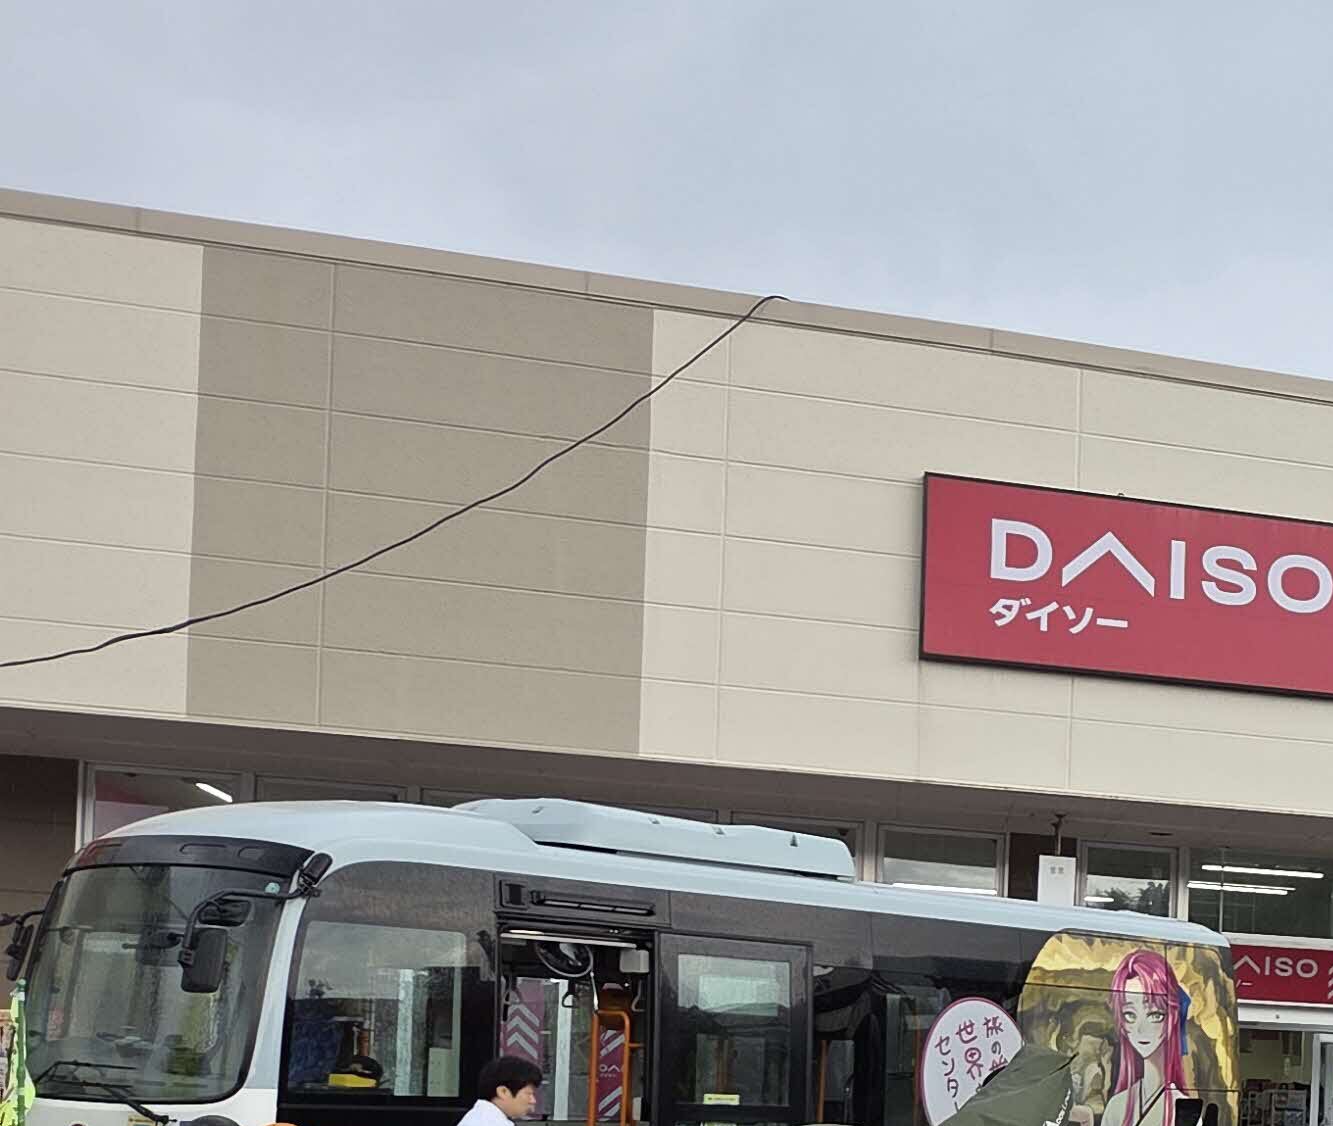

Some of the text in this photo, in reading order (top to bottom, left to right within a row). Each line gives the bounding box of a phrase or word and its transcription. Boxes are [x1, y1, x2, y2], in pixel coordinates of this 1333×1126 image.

[989, 518, 1333, 614] DAISO
[989, 597, 1128, 635] ダイソー
[1233, 954, 1318, 978] AISO
